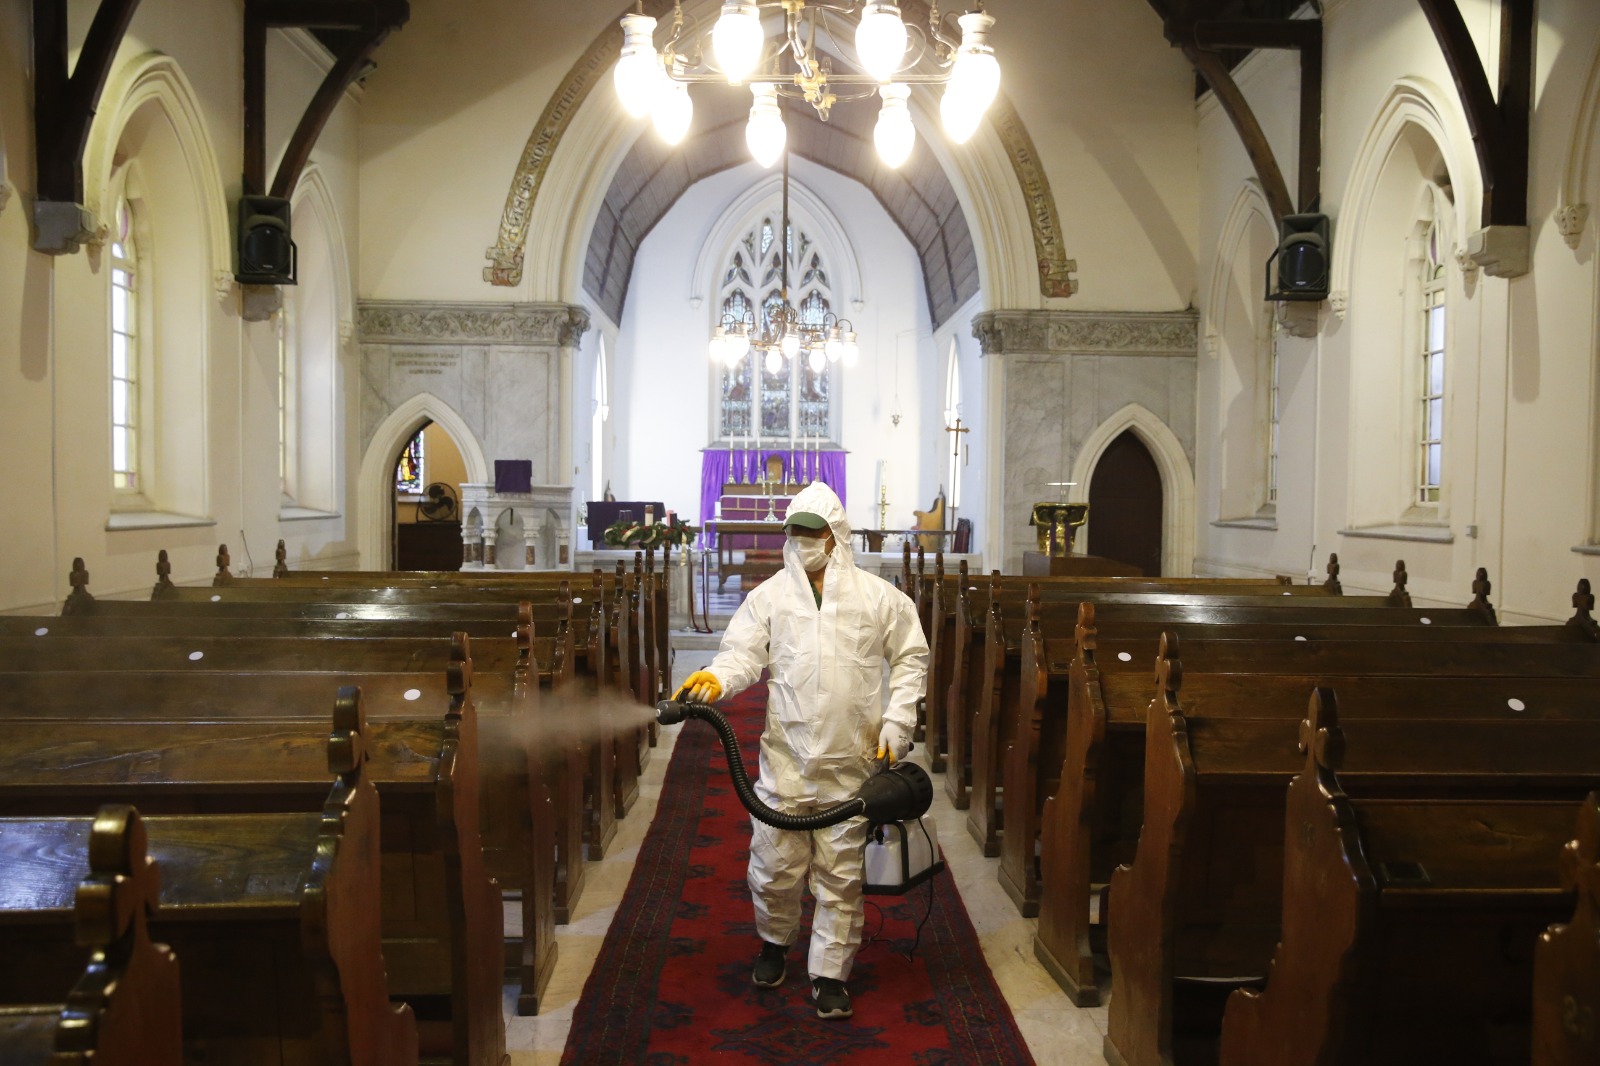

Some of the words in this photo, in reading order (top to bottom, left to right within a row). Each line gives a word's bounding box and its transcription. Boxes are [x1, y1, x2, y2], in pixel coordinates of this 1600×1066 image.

[530, 127, 554, 169] NONE
[552, 75, 586, 121] OTHER
[1017, 147, 1033, 167] OF
[1025, 181, 1056, 247] HEAVEN
